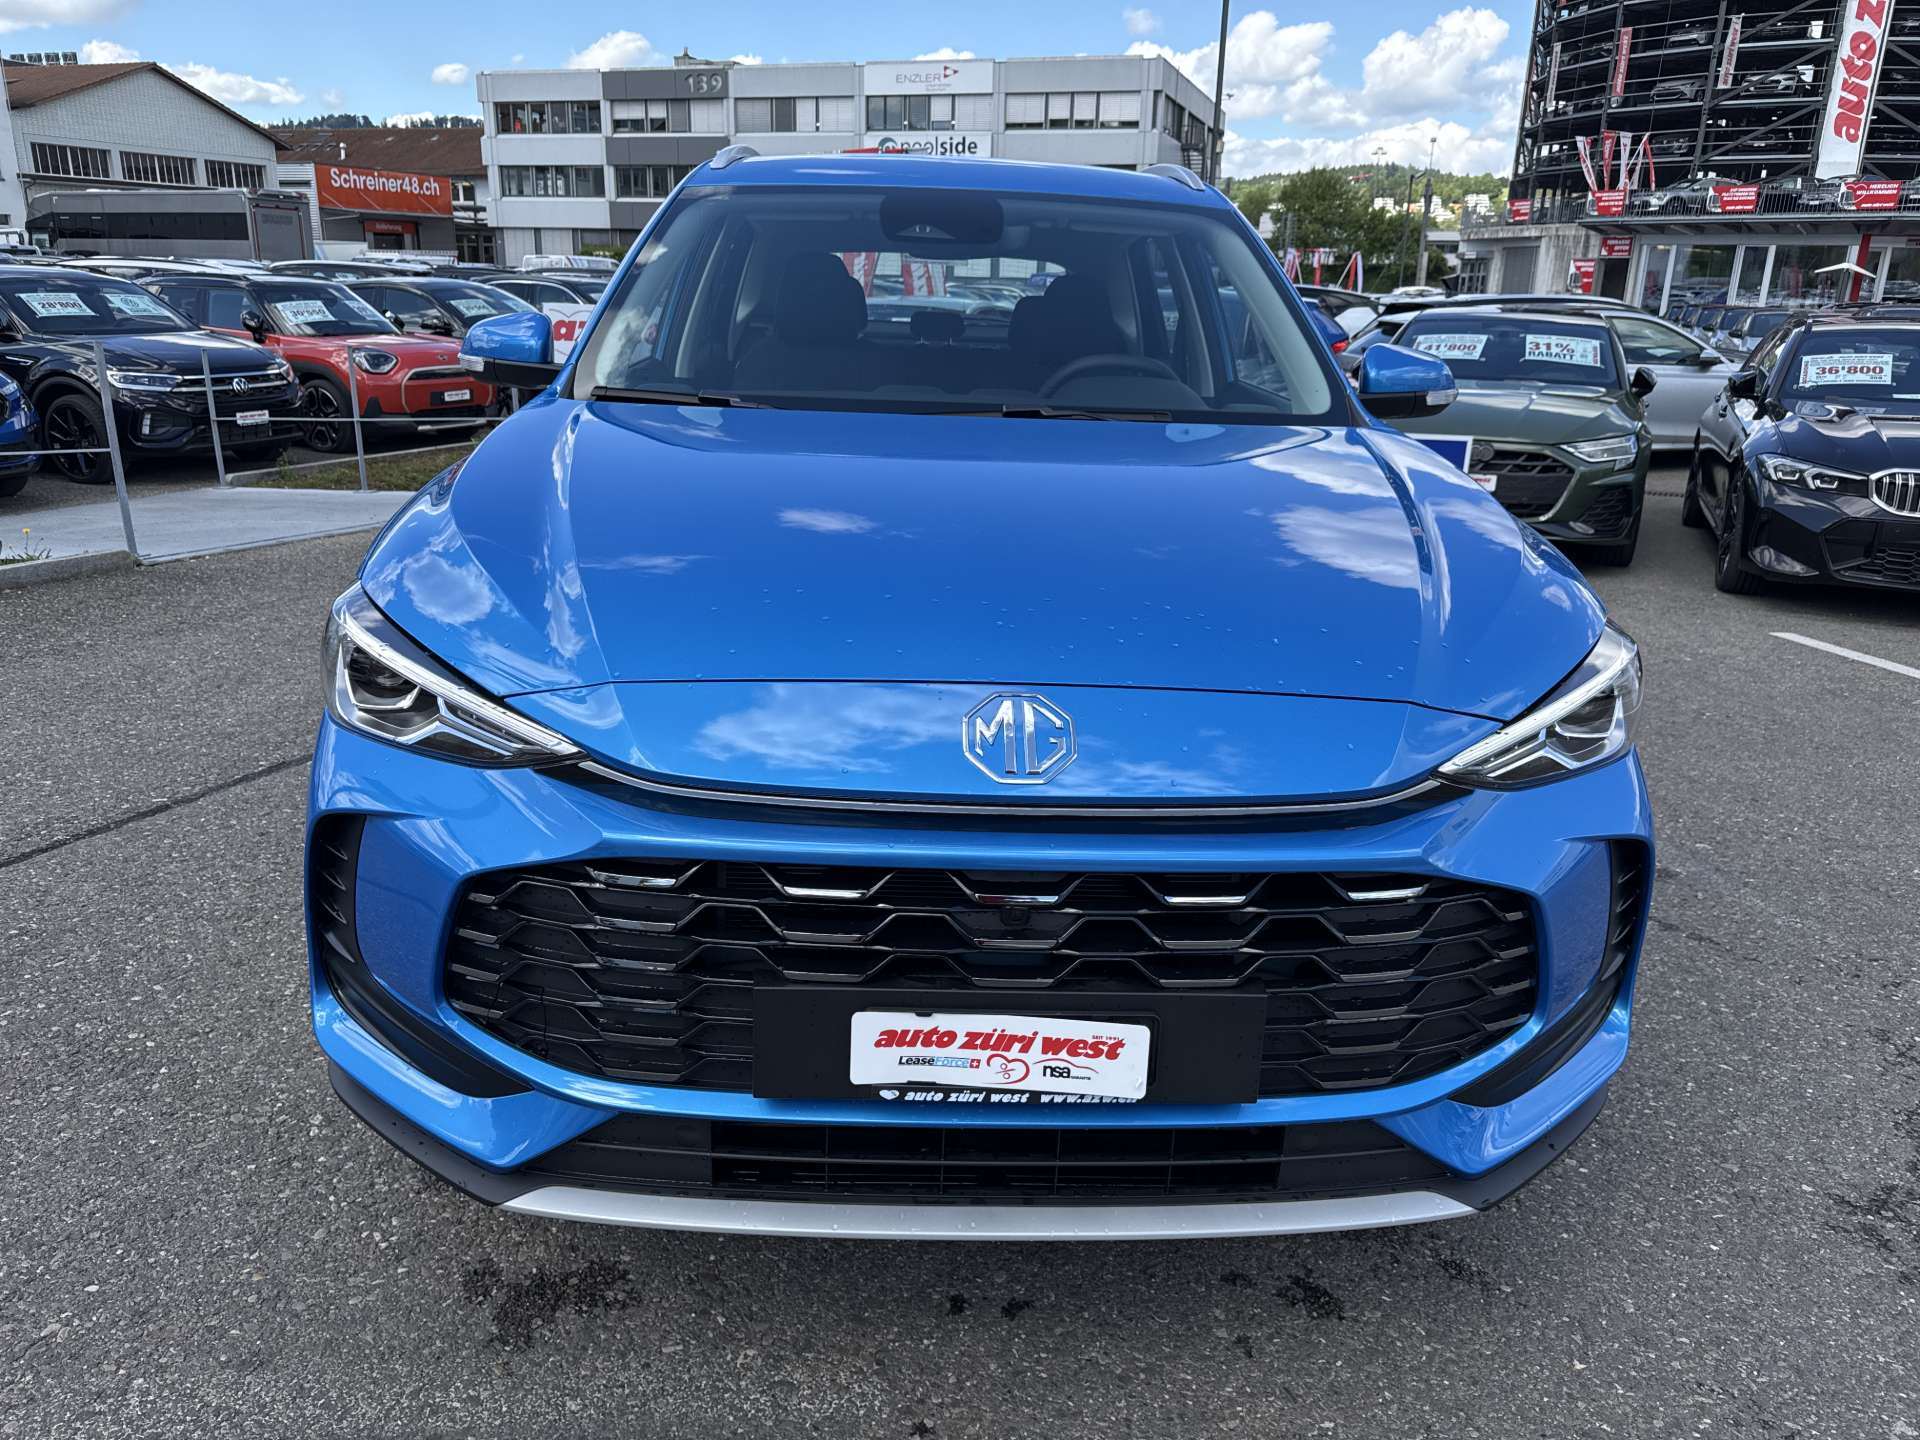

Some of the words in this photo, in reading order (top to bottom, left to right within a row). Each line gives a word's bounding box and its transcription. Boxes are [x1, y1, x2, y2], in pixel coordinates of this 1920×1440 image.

[685, 73, 722, 93] 139
[895, 72, 942, 83] ENZLER
[1834, 30, 1877, 144] auto
[330, 167, 440, 196] Schreiner48.ch
[1423, 343, 1477, 352] 41'800
[1528, 350, 1577, 361] RABATT
[1816, 365, 1884, 376] 36'800
[975, 699, 1067, 775] MG
[874, 1025, 957, 1050] auto
[957, 1027, 1039, 1054] züri
[1041, 1035, 1126, 1061] west
[898, 1055, 970, 1069] LeaseForce
[1042, 1064, 1071, 1080] nsa
[904, 1089, 944, 1102] auto
[948, 1088, 985, 1103] züri
[989, 1092, 1030, 1103] west
